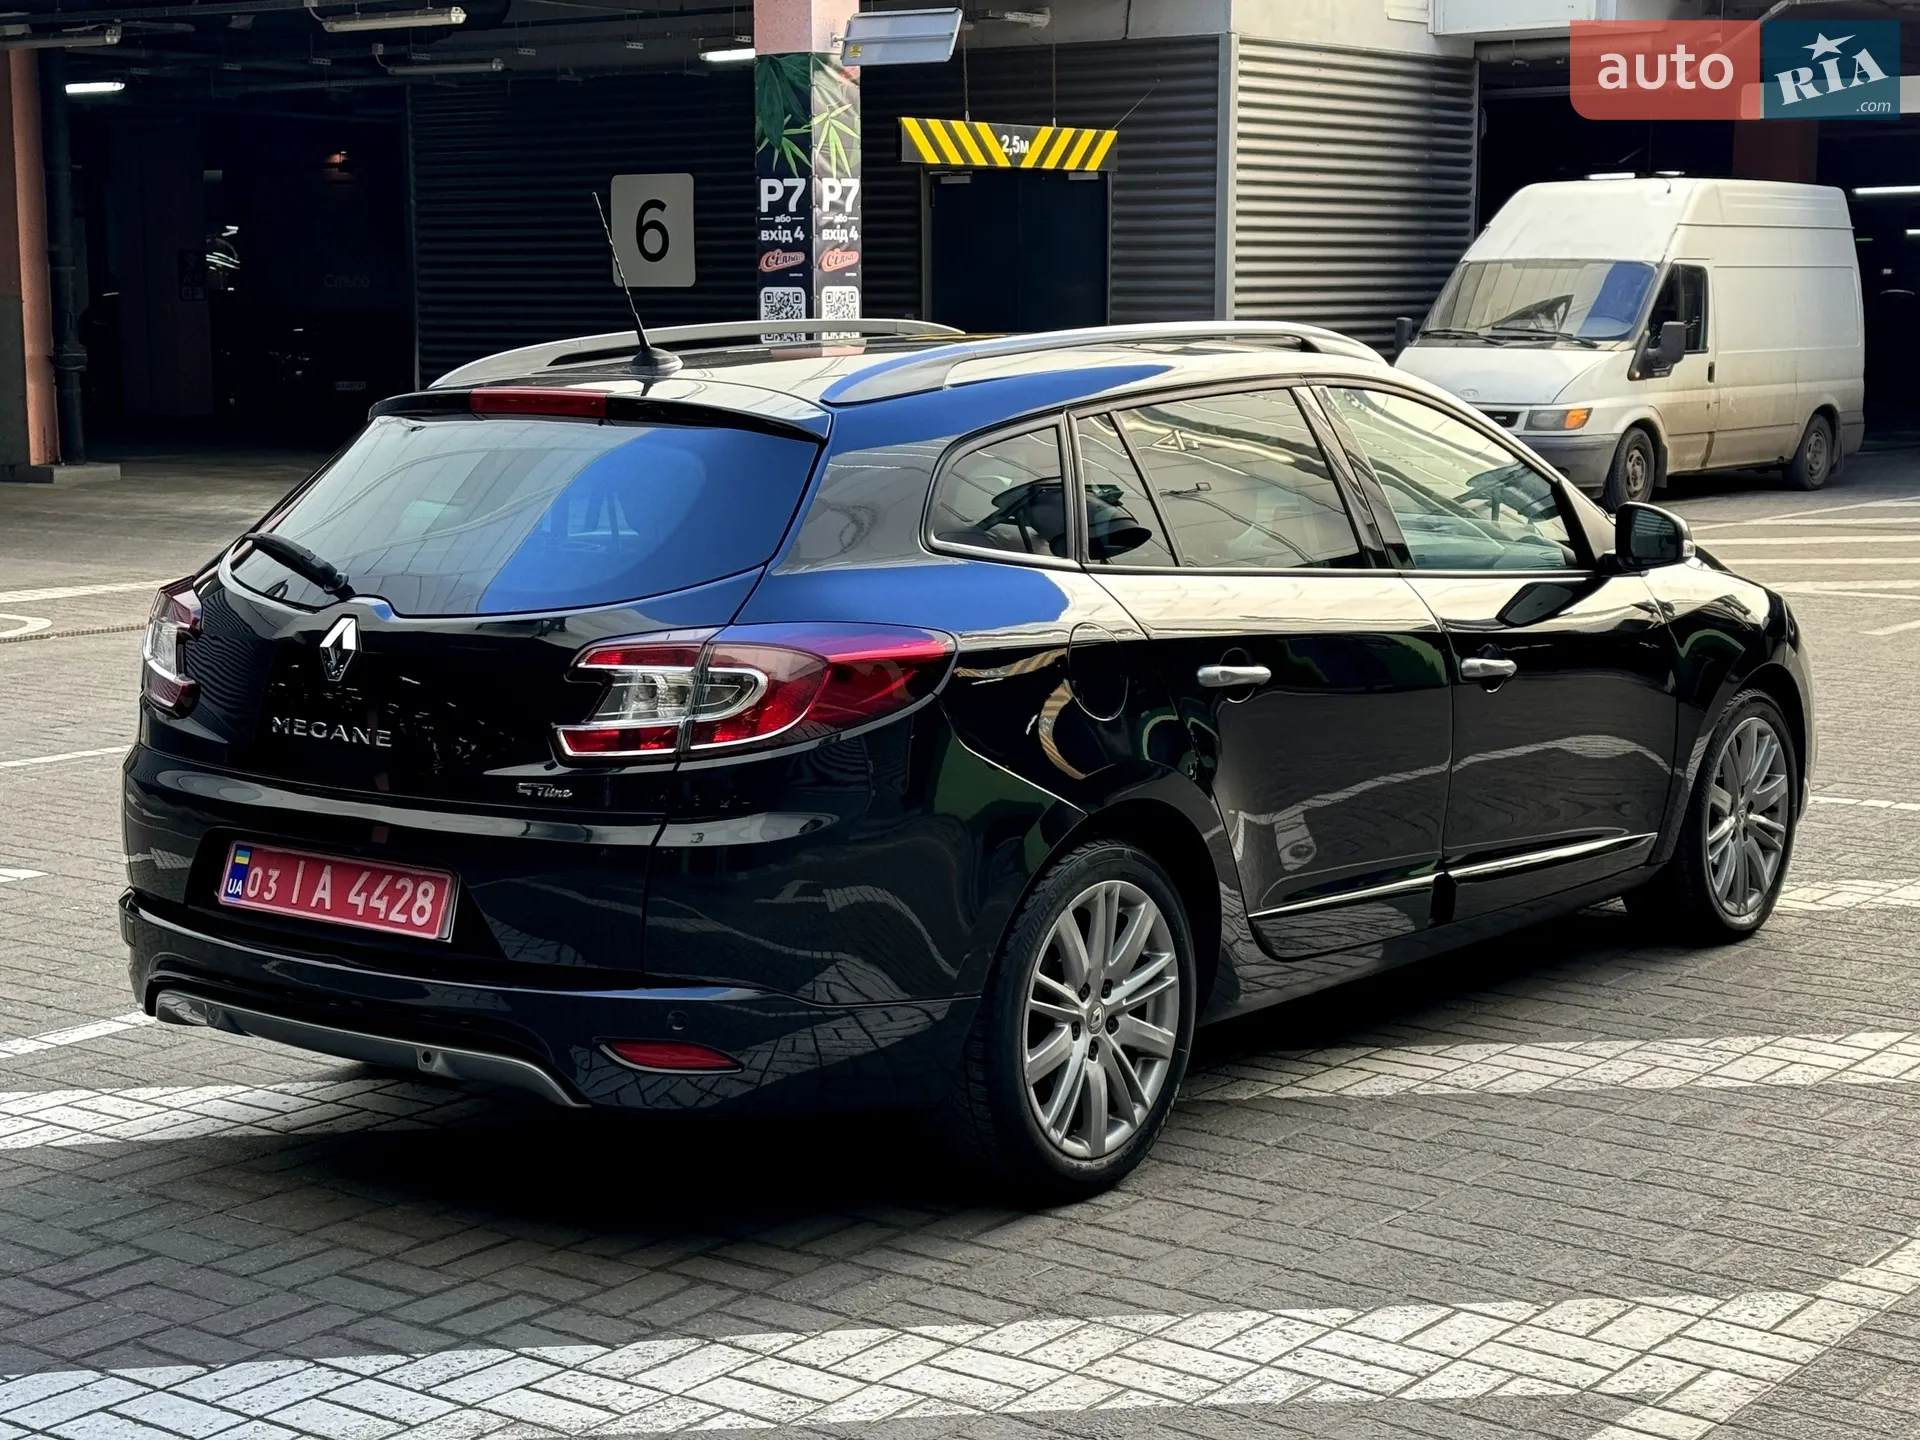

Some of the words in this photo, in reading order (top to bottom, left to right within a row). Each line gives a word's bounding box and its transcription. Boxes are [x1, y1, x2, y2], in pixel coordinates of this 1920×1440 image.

[760, 178, 806, 212] P7
[821, 178, 860, 212] P7
[636, 199, 670, 262] 6
[774, 214, 792, 223] або
[834, 213, 848, 223] або
[760, 225, 793, 243] вхід
[793, 225, 805, 241] 4
[821, 224, 849, 243] вхід
[848, 225, 859, 241] 4
[272, 716, 393, 748] MEGANE
[227, 878, 243, 896] UA
[347, 871, 436, 927] 4428
